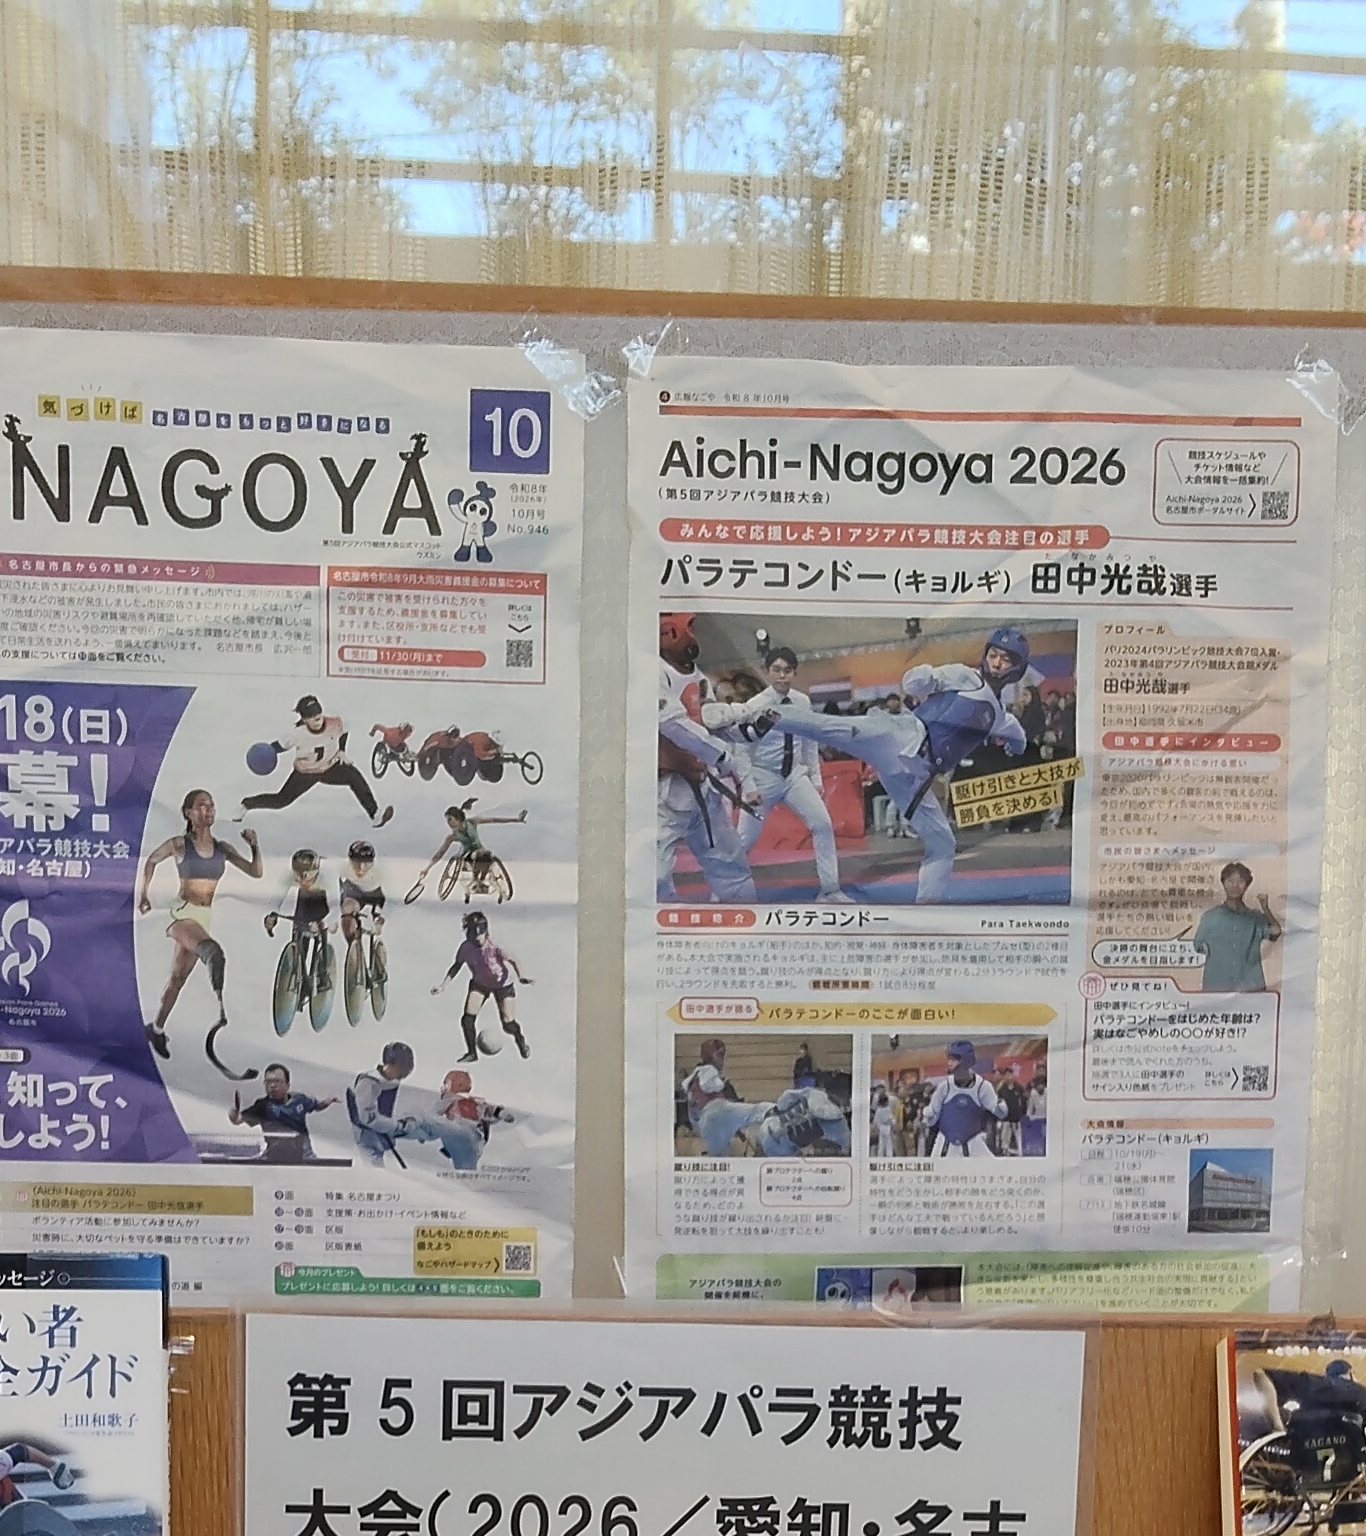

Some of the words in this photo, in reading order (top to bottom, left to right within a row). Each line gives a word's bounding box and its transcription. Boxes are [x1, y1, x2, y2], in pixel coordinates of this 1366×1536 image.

[484, 406, 542, 459] 10
[3, 428, 443, 539] NAGOYA
[658, 436, 994, 496] Aichi-Nagoya
[1009, 445, 1126, 488] 2026
[1031, 561, 1219, 599] 田中光哉選手
[954, 760, 1081, 801] 駆け引きと大技が
[765, 910, 890, 928] パラテコンドー
